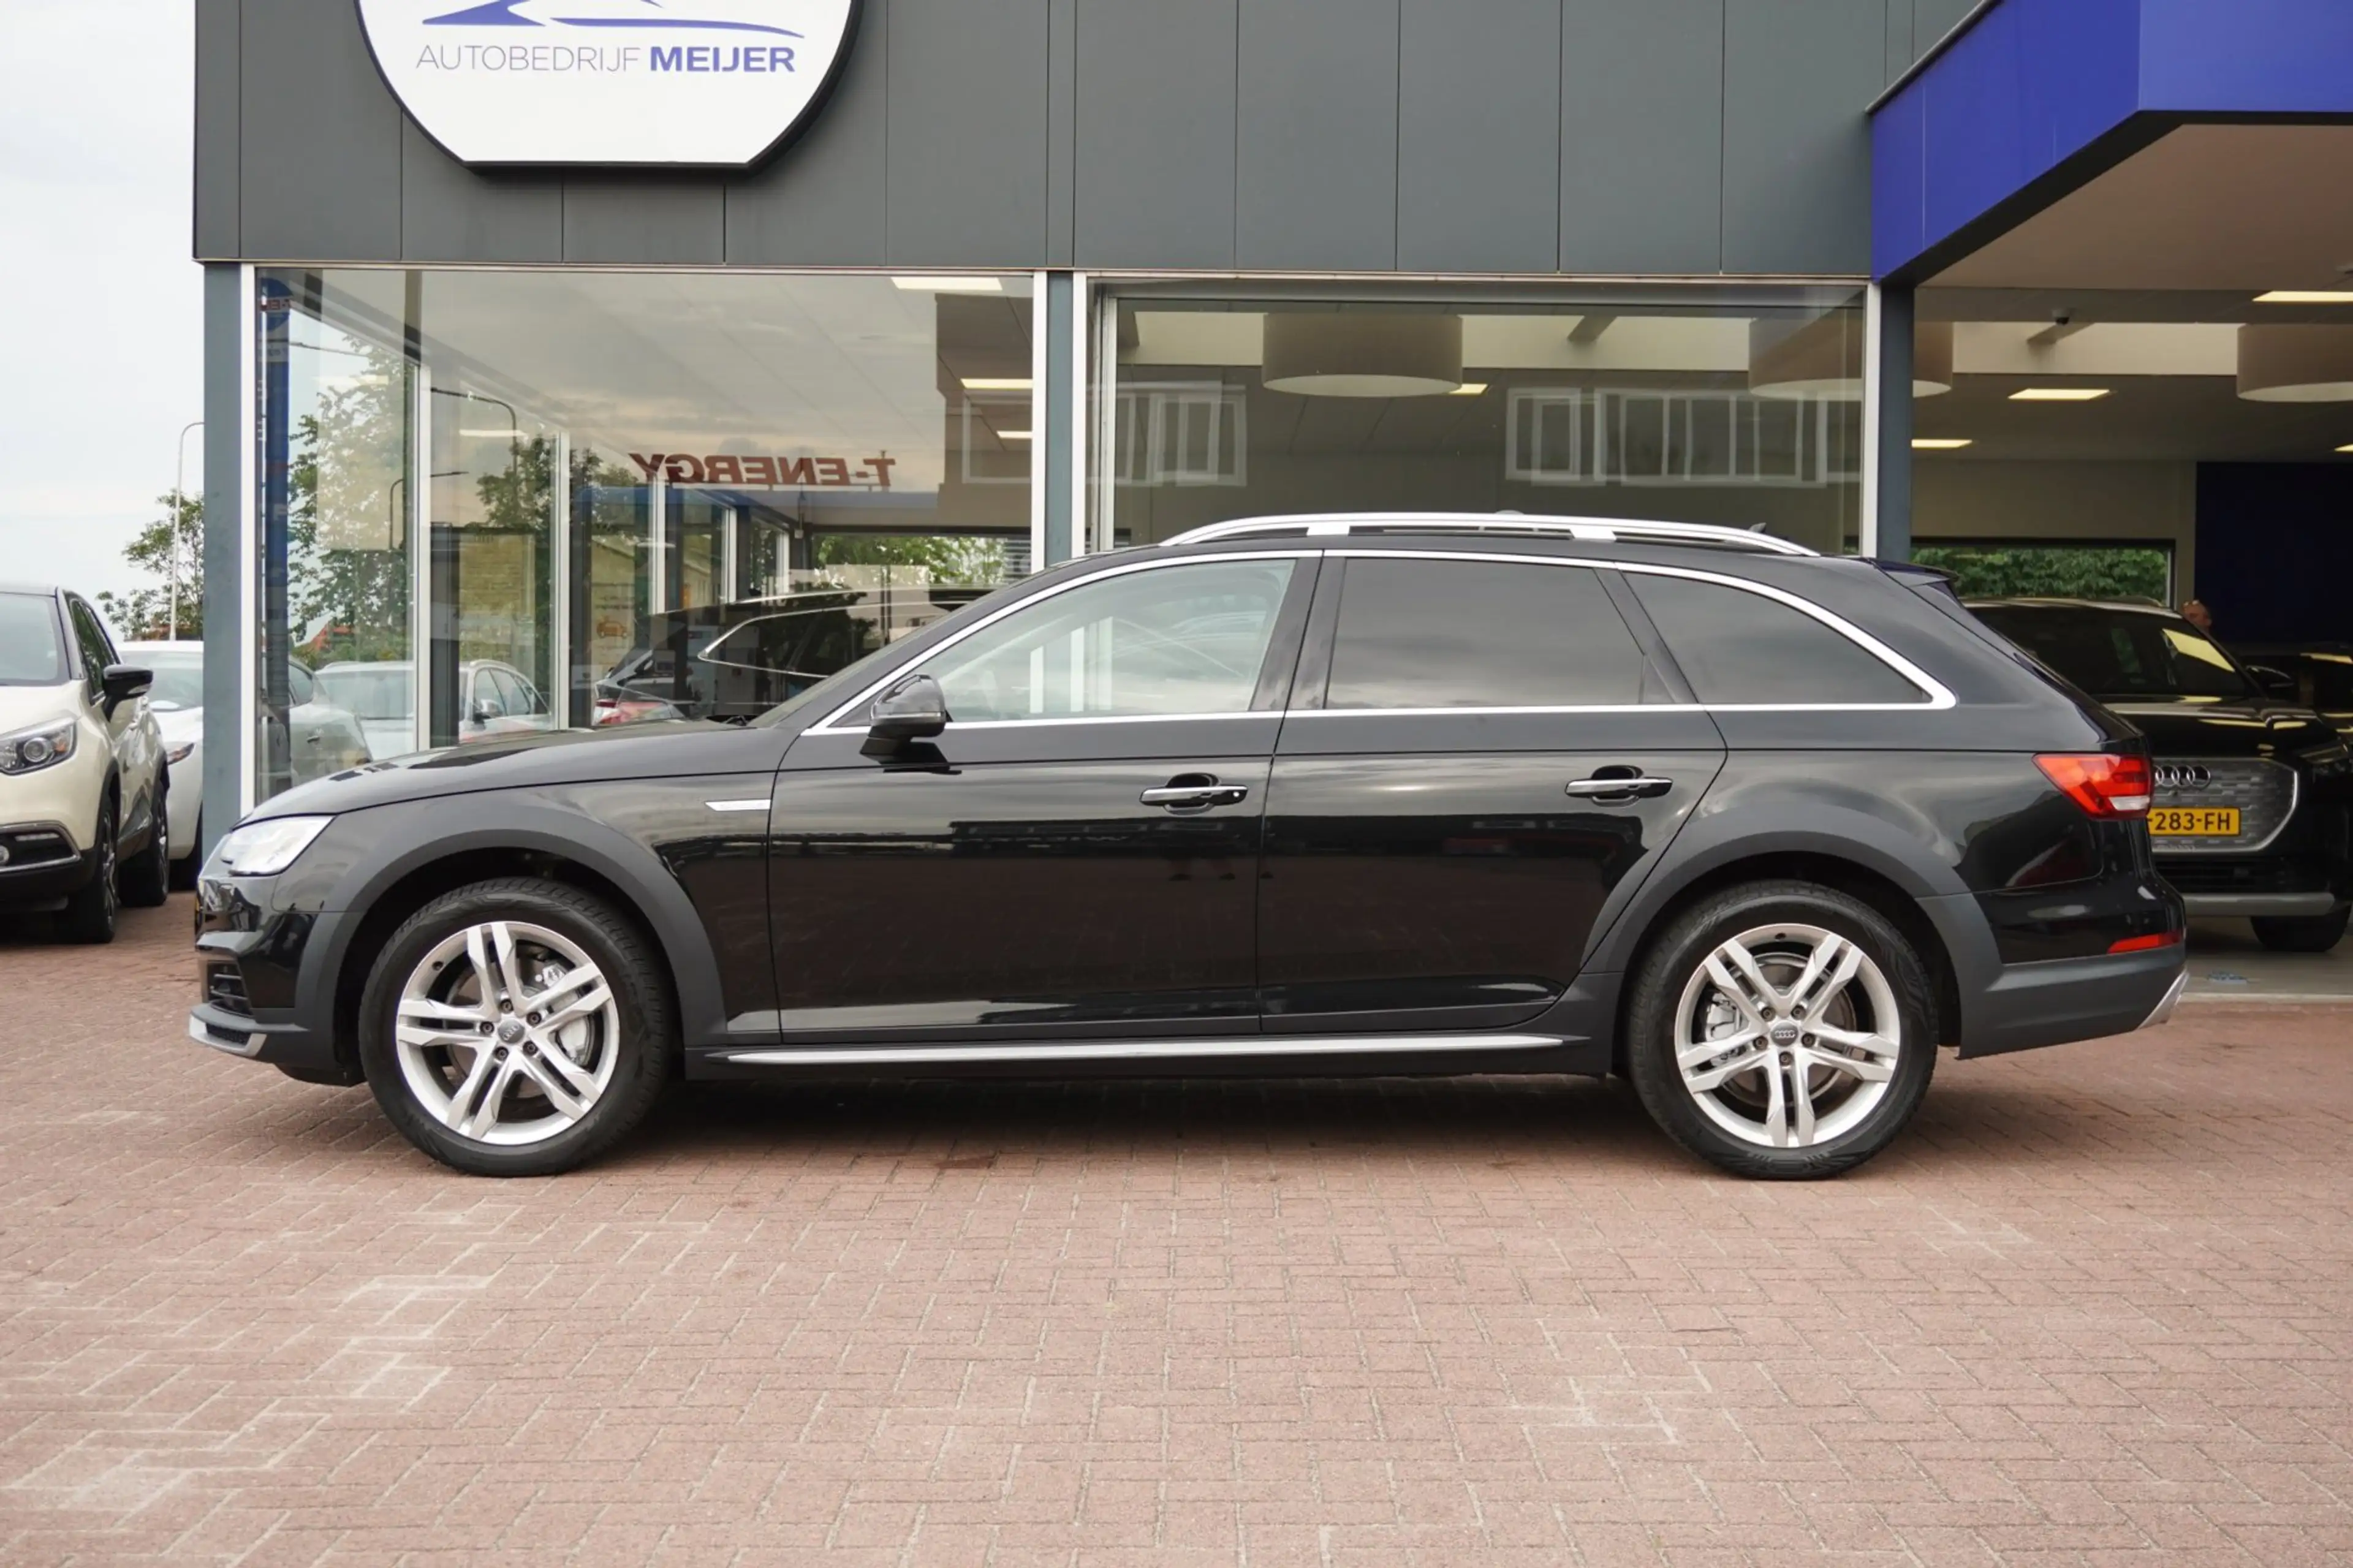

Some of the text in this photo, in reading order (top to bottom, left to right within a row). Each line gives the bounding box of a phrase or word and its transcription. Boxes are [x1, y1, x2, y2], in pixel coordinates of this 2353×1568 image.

[416, 44, 795, 72] AUTOBEDRIJF MEIJER
[2147, 812, 2230, 831] -283-FH
